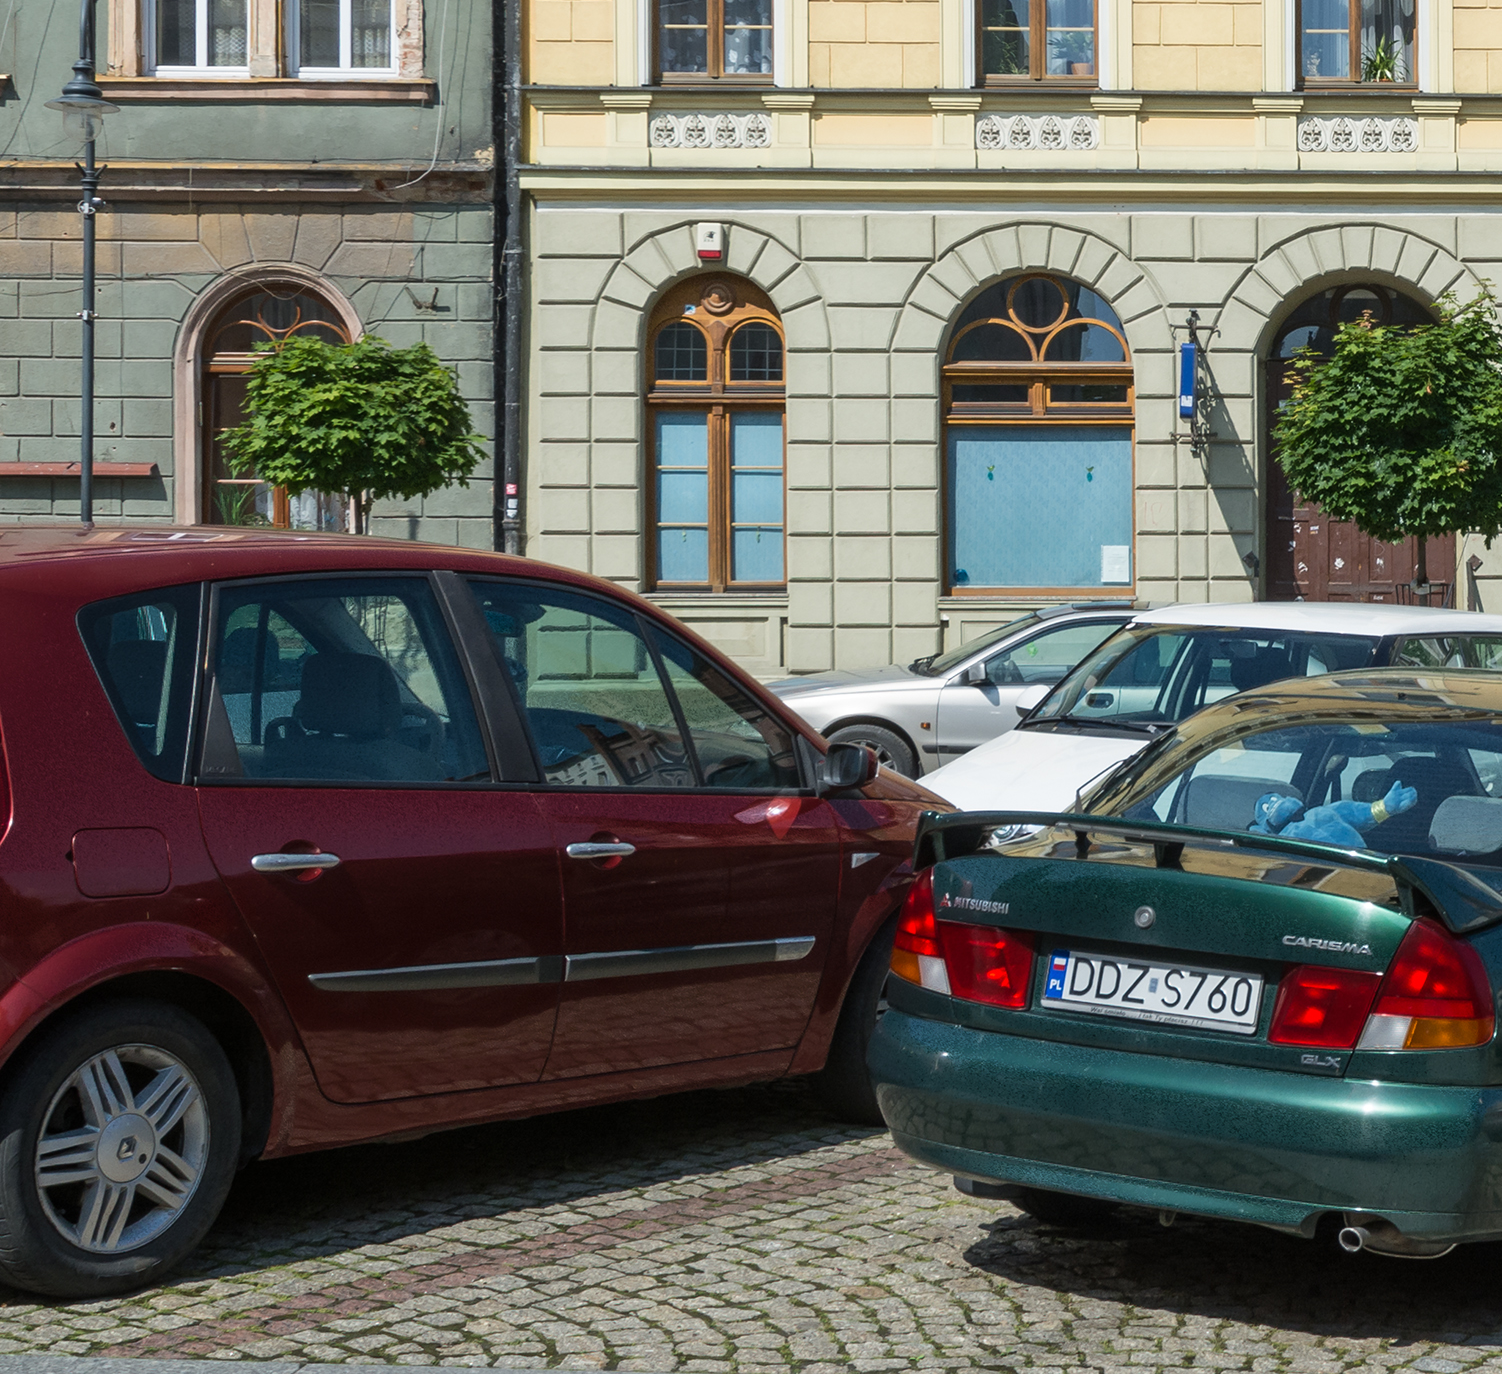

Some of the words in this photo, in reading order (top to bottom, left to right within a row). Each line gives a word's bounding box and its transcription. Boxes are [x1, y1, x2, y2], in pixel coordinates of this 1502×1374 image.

[953, 896, 1010, 915] MITSUBISHI
[1282, 934, 1373, 956] CARISMA
[1048, 978, 1063, 992] PL
[1068, 956, 1150, 1004] DDZ
[1160, 968, 1254, 1017] S760
[1301, 1054, 1341, 1068] GLX
